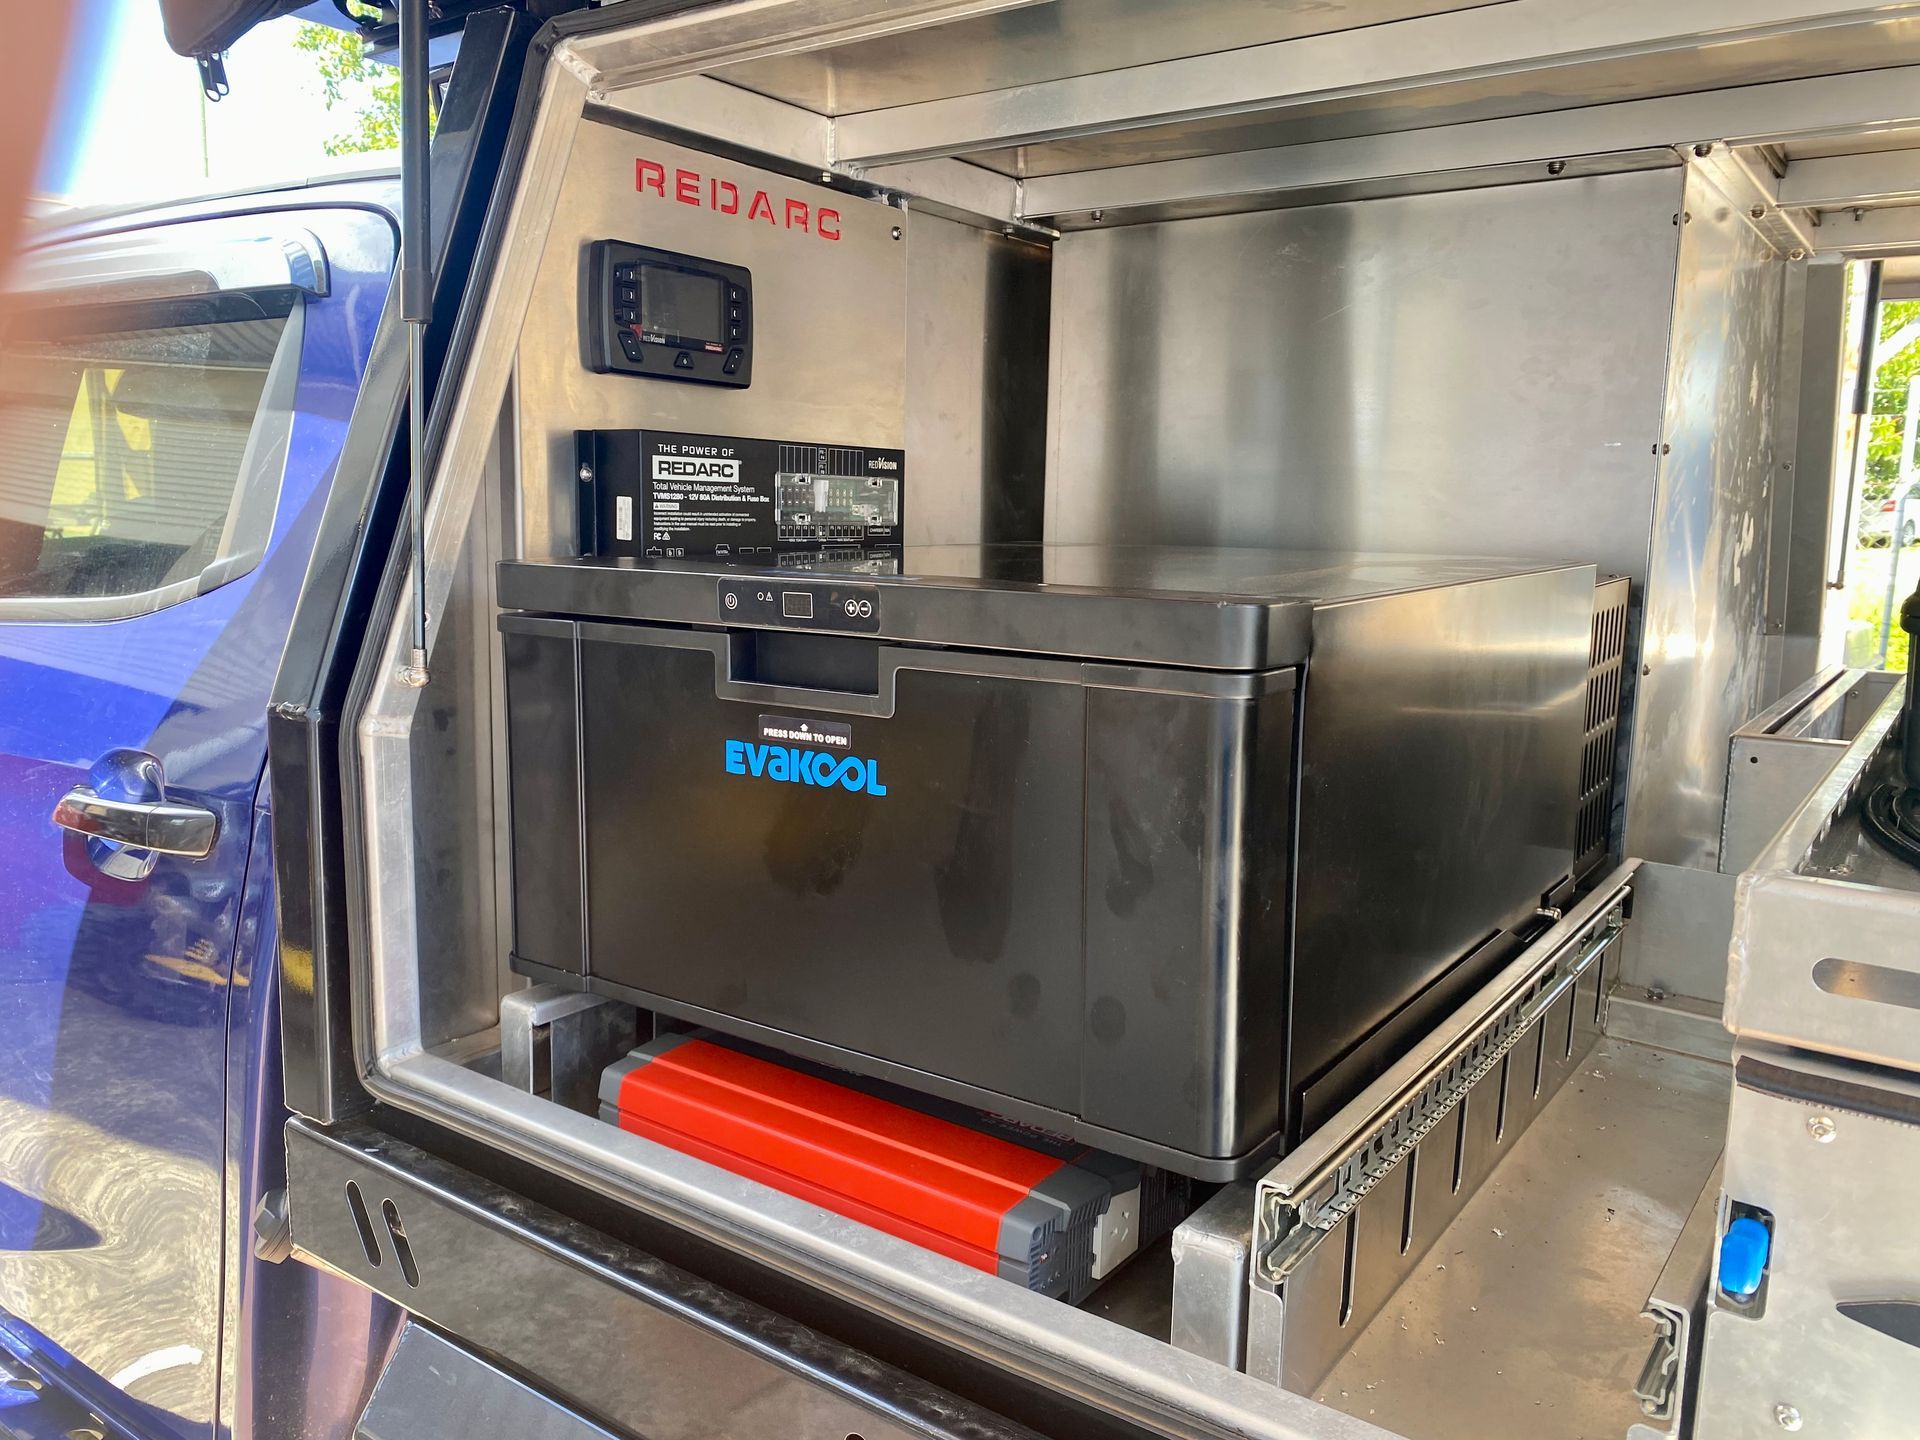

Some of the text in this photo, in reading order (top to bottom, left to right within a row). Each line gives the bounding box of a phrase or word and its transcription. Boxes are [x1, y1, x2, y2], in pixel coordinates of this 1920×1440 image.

[635, 158, 842, 242] REDARC
[658, 444, 734, 456] THE POWER OF
[658, 460, 734, 478] REDARC
[652, 482, 755, 495] Total Vehicle Management System
[652, 492, 684, 500] TVMS1280
[764, 728, 847, 745] PRESS DOWN TO OPEN
